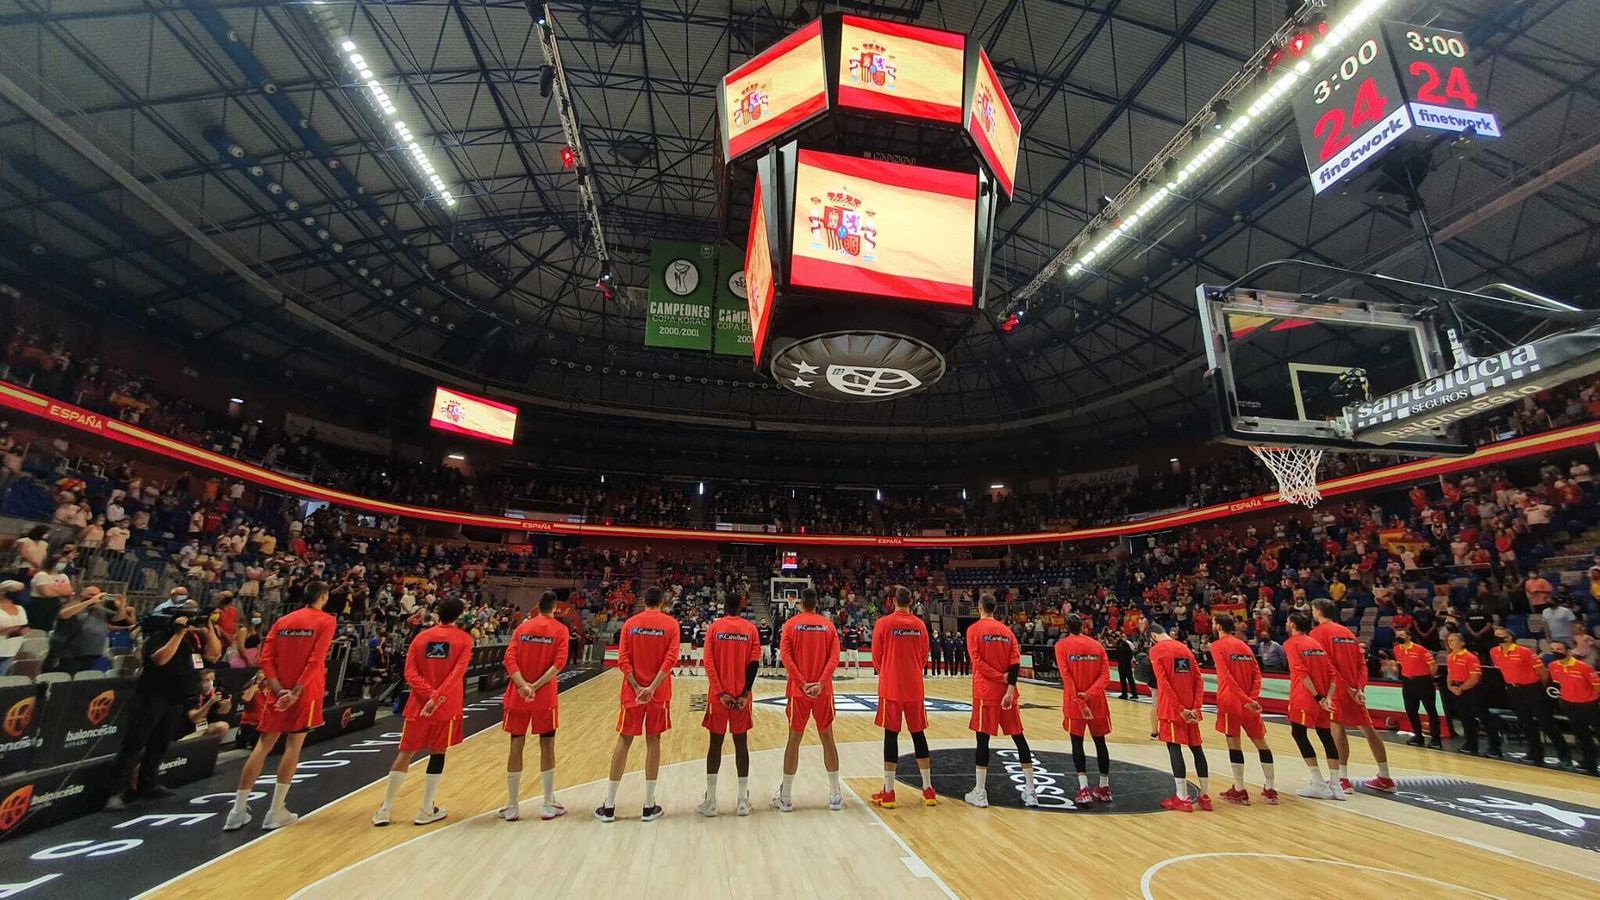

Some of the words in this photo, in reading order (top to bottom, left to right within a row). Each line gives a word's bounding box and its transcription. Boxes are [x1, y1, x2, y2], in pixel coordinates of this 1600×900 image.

[1406, 31, 1465, 58] 3:00
[1313, 39, 1378, 104] 3:00
[1408, 61, 1478, 109] 24
[1313, 76, 1388, 163] 24
[1418, 108, 1493, 131] finetwork
[1318, 117, 1404, 183] finetwork
[649, 301, 711, 318] CAMPEONES
[651, 314, 676, 323] COPA
[659, 326, 700, 337] 2000/2001
[716, 322, 740, 331] COPA
[737, 335, 753, 344] 200
[1411, 388, 1468, 414] SEGUROS
[50, 404, 103, 430] ESPAÑA
[1230, 498, 1263, 512] ESPAÑA
[521, 522, 552, 530] ESPAÑA
[65, 724, 118, 742] baloncesto
